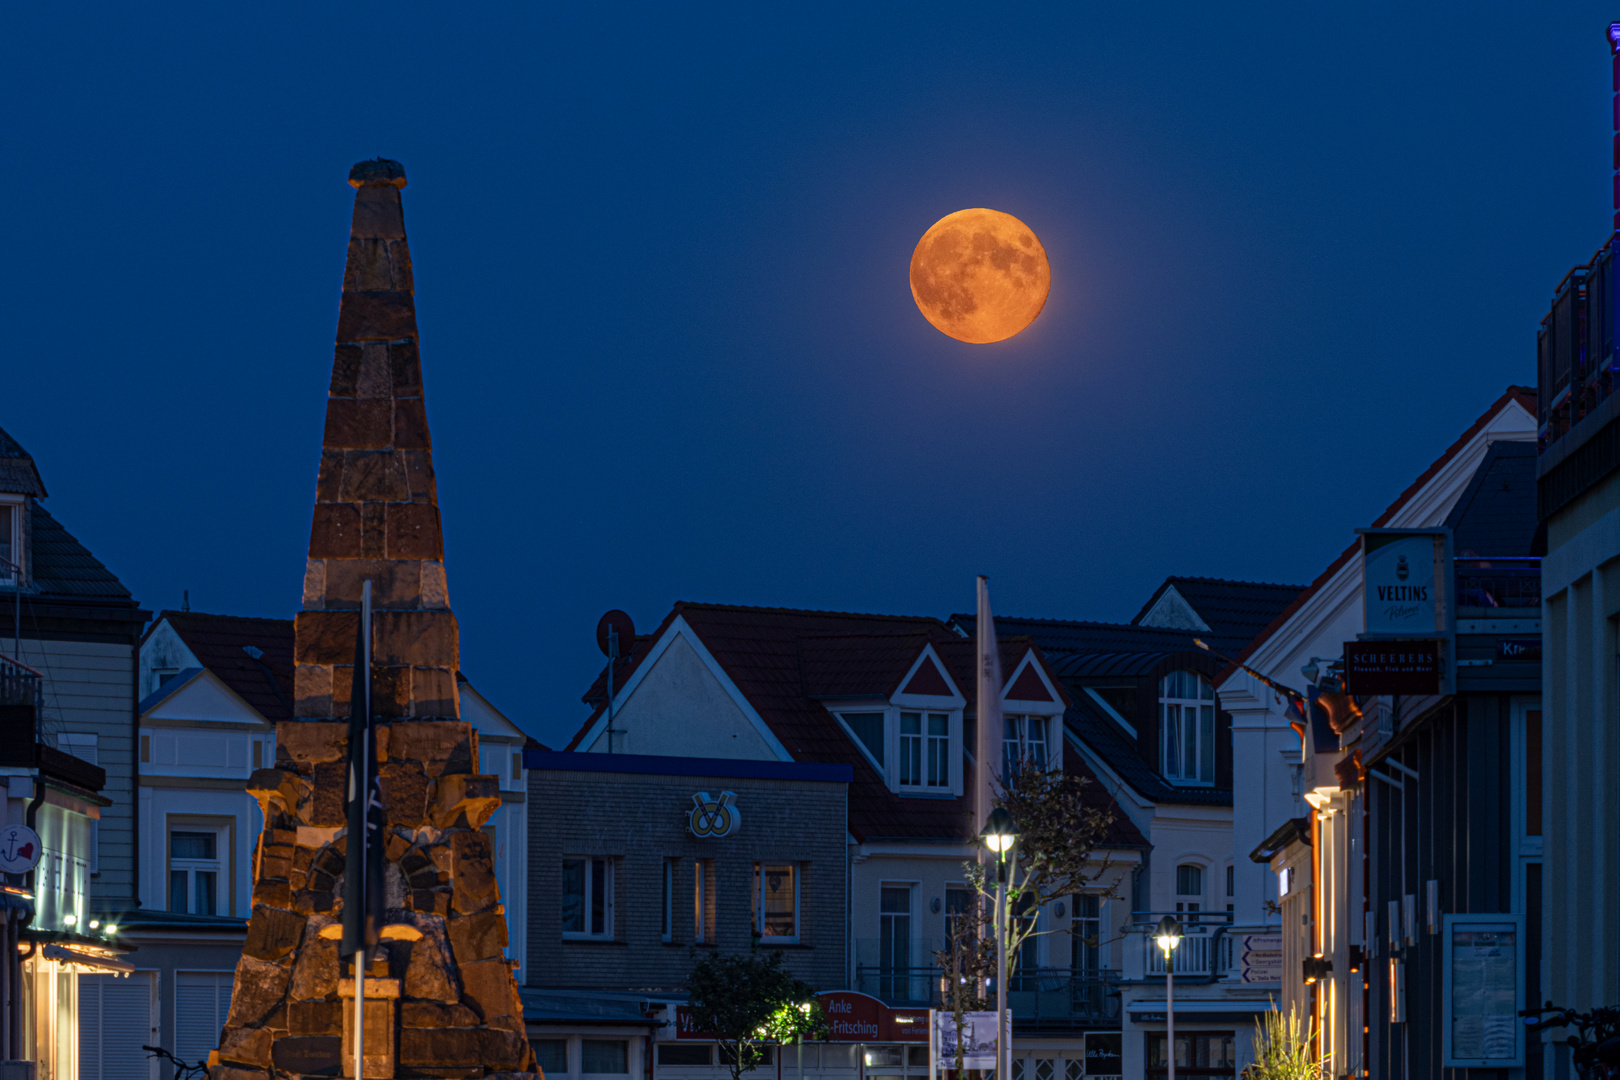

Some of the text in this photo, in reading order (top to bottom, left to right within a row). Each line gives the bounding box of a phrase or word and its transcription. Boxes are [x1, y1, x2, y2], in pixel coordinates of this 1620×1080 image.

[1377, 586, 1427, 601] VELTINS
[1353, 653, 1434, 664] SCHEERERS
[828, 999, 852, 1014] Anke
